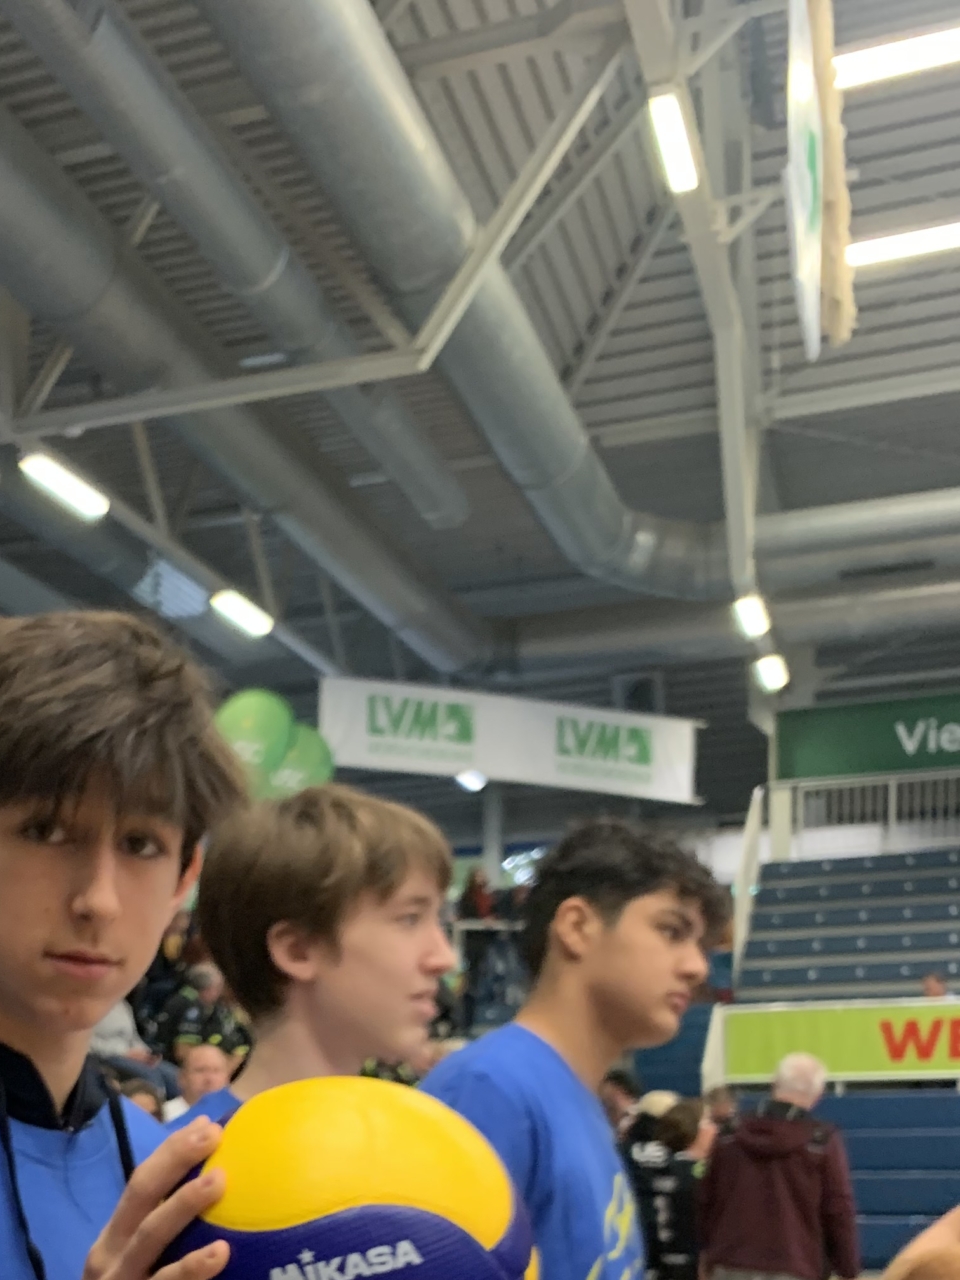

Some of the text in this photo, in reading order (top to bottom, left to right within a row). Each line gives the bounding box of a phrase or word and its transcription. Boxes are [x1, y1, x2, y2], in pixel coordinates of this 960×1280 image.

[367, 694, 439, 741] LVM
[555, 715, 620, 762] LVM
[879, 1017, 960, 1063] W
